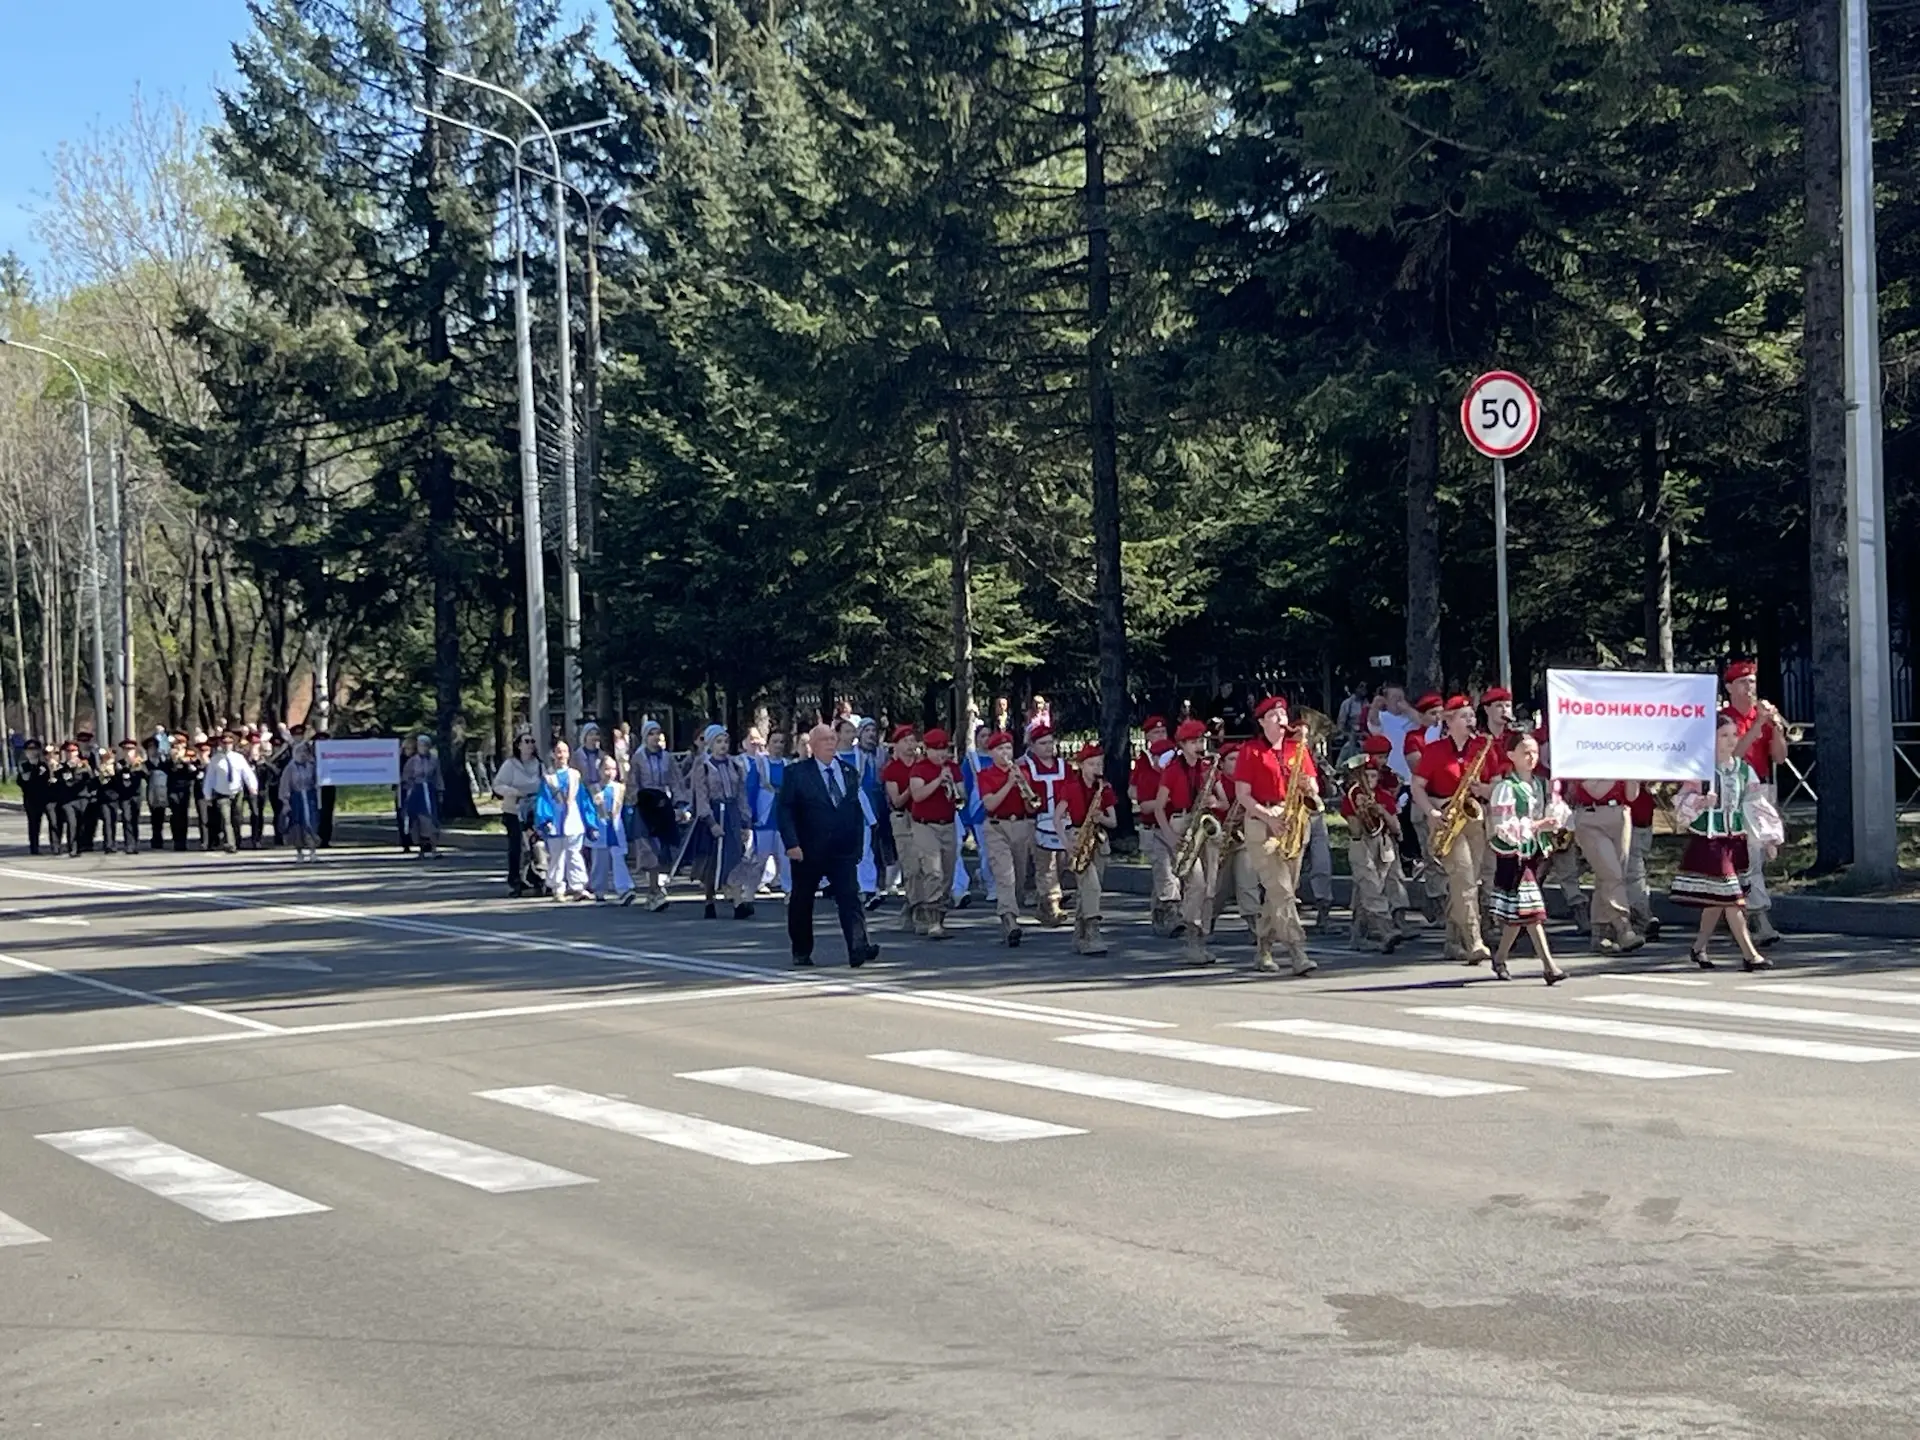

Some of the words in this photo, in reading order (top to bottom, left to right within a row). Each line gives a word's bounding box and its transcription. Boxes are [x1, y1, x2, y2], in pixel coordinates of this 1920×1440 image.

[1481, 398, 1521, 430] 50
[1557, 697, 1705, 719] Новоникольск
[1576, 740, 1654, 752] ПРИМОРСКИЙ
[1657, 740, 1687, 752] КРАЙ
